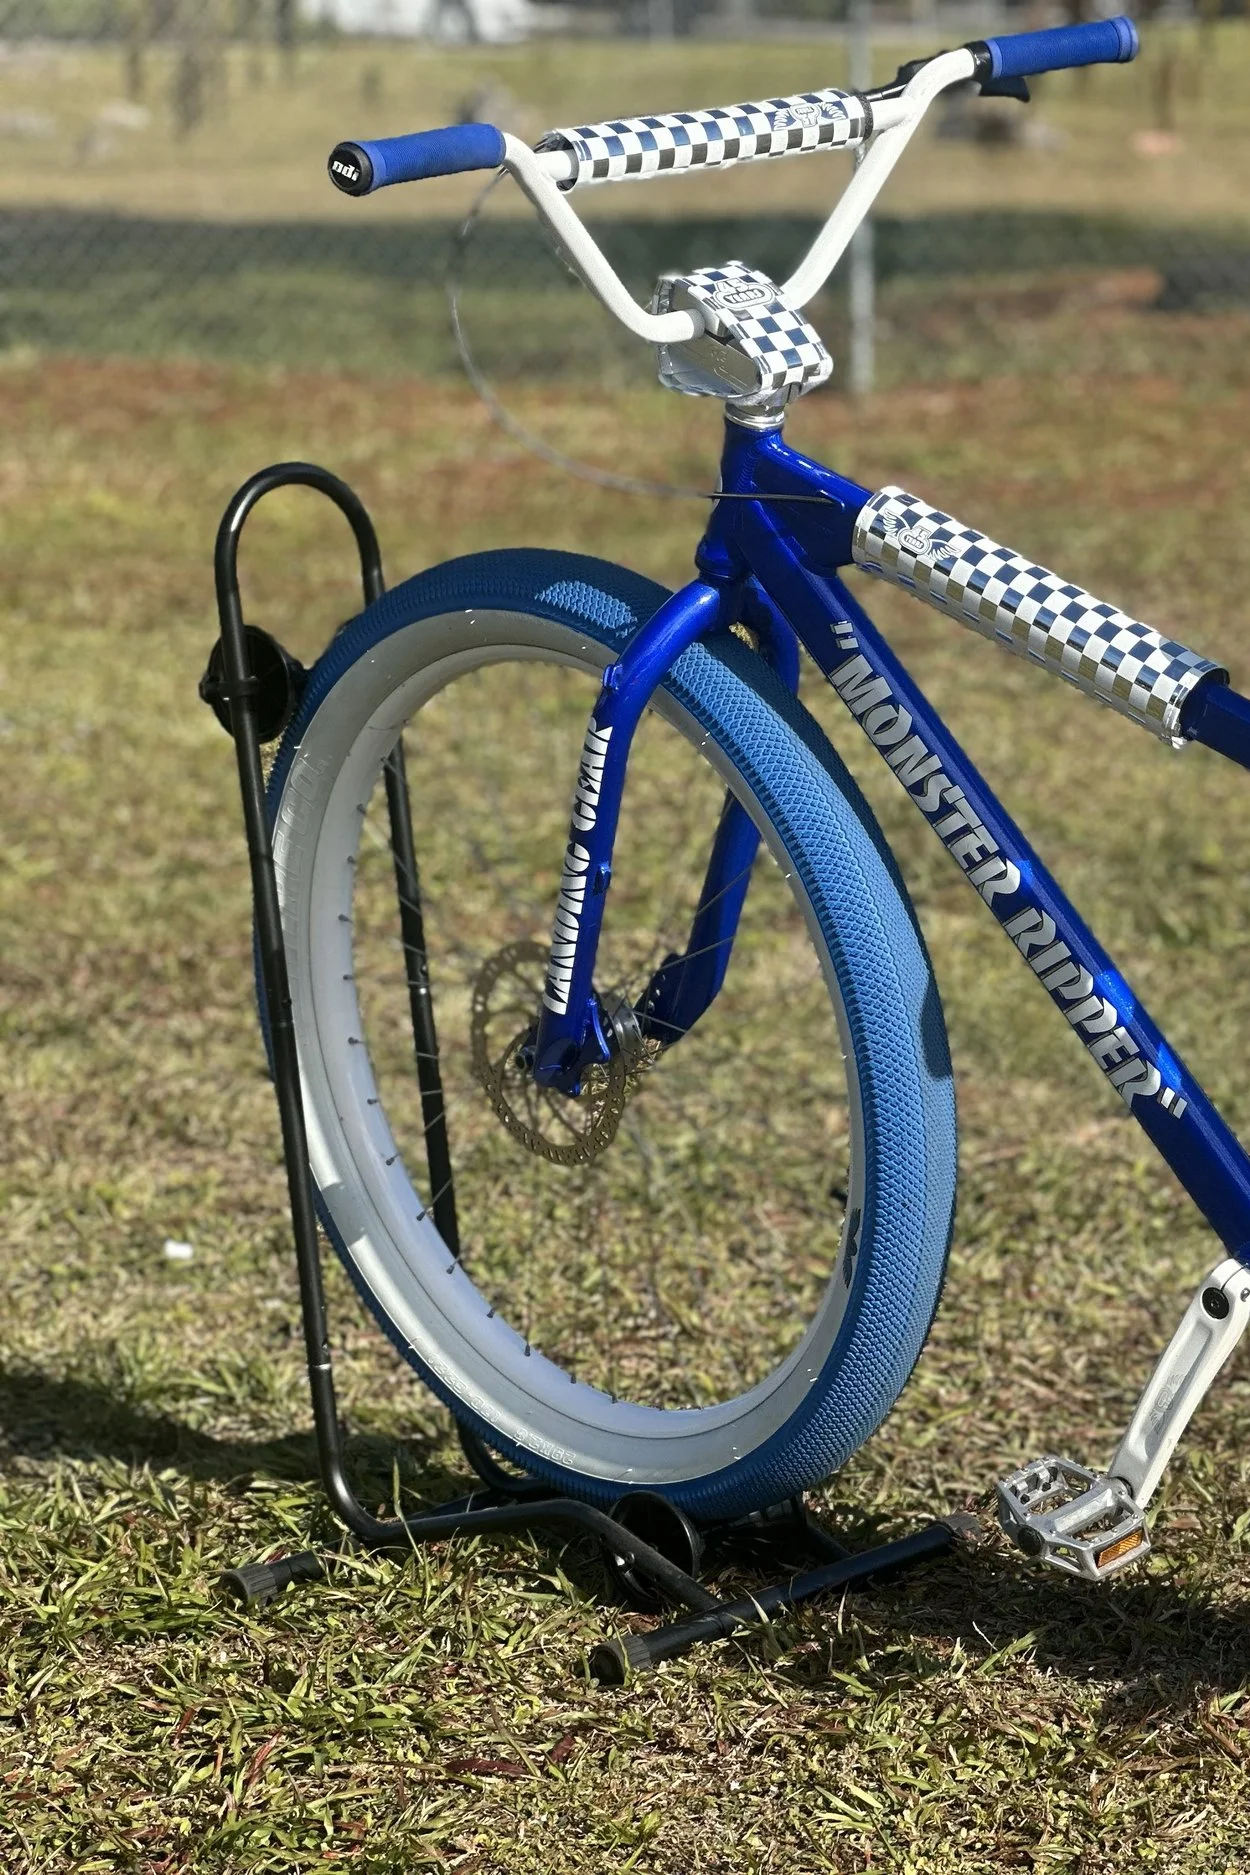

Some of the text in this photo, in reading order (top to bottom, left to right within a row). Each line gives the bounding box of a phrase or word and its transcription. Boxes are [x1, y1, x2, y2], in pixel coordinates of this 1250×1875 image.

[332, 160, 360, 182] odi
[718, 278, 748, 294] 45
[724, 288, 766, 305] YEARS
[543, 716, 613, 1015] LANDING GEAR
